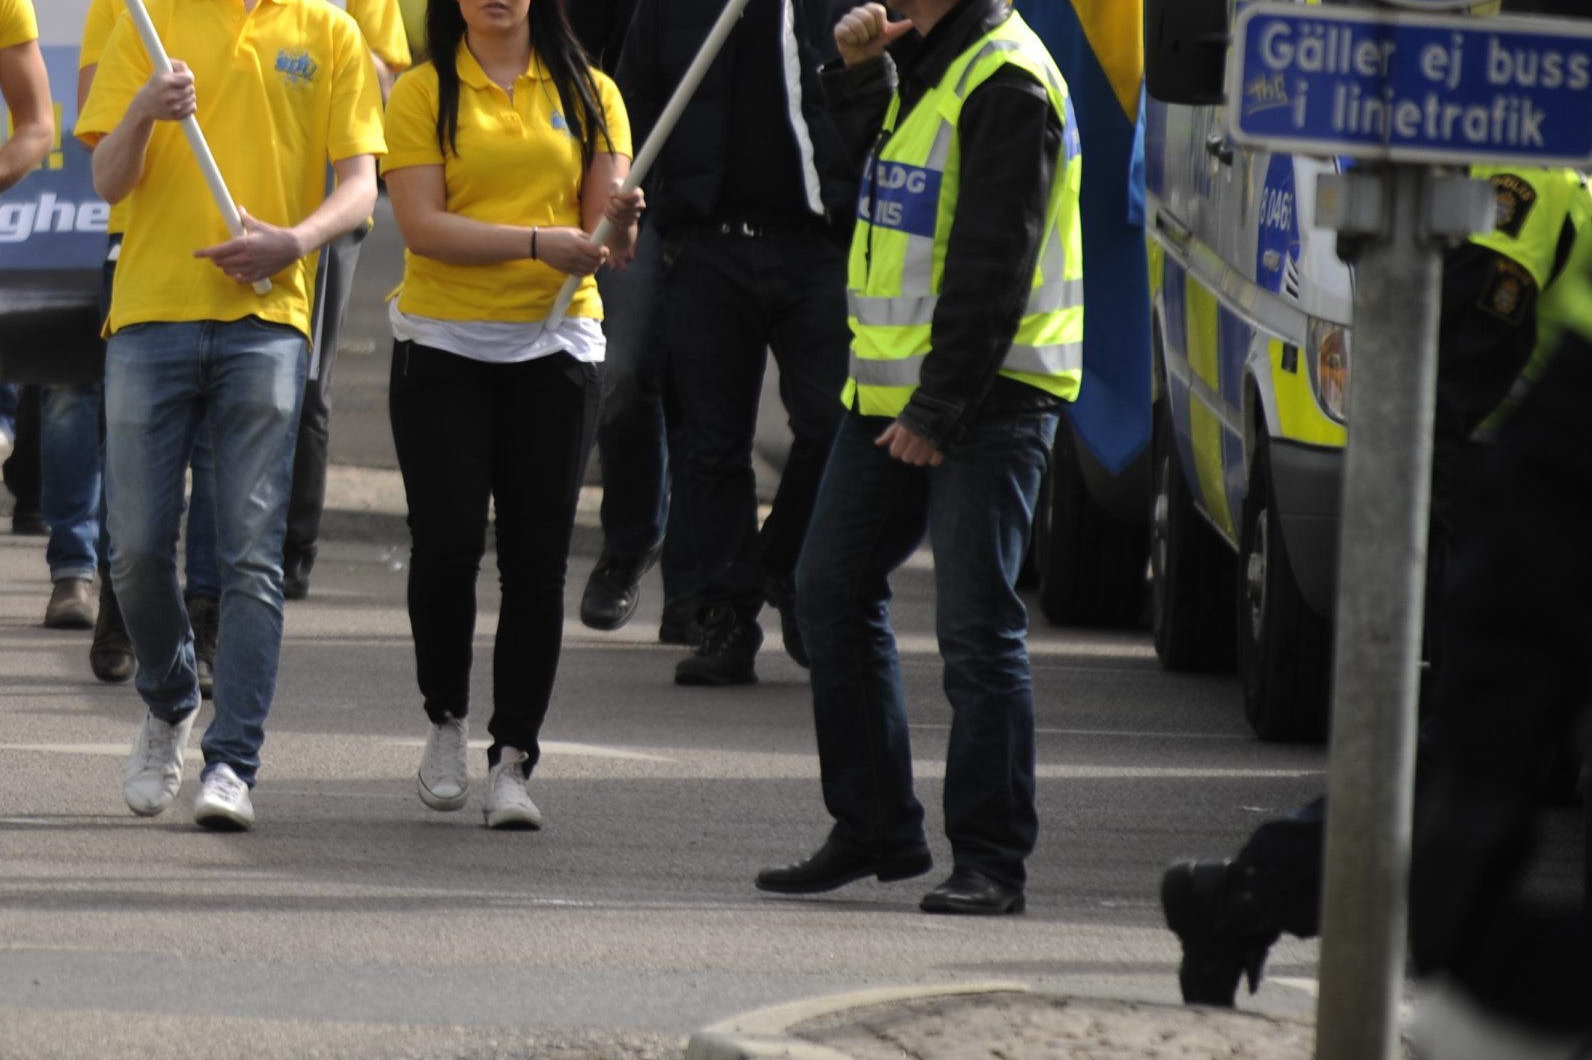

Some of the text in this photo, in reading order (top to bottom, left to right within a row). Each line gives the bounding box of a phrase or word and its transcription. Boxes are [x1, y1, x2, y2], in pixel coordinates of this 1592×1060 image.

[1262, 21, 1590, 90] Gäller ej buss
[1294, 84, 1307, 128] i
[1332, 83, 1546, 147] linjetrafik
